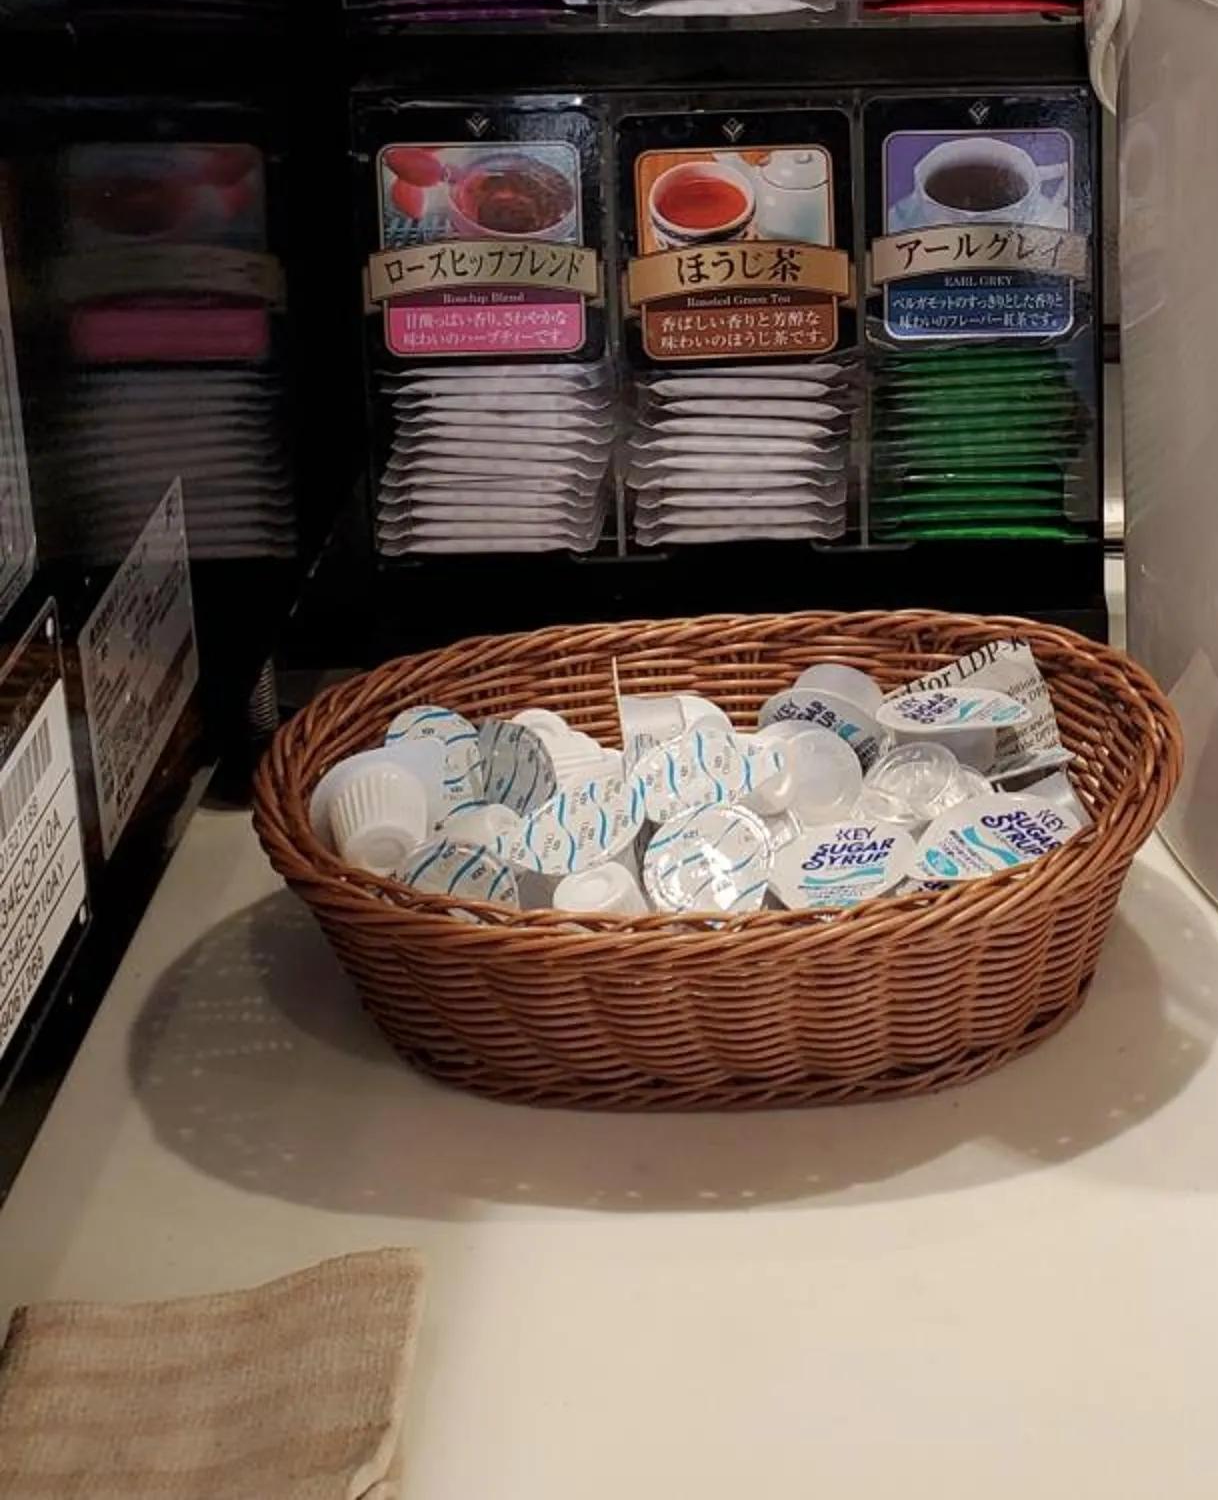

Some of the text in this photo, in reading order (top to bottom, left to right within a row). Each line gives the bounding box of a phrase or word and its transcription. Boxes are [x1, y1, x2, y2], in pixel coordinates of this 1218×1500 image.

[895, 229, 1066, 270] アールグレイ
[676, 247, 806, 286] ほうじ茶
[660, 329, 828, 350] 味わいのほうじ茶です。
[1037, 808, 1067, 833] KEY
[836, 824, 878, 841] KEY
[815, 838, 896, 857] SUGAR
[801, 850, 889, 871] SYRUP
